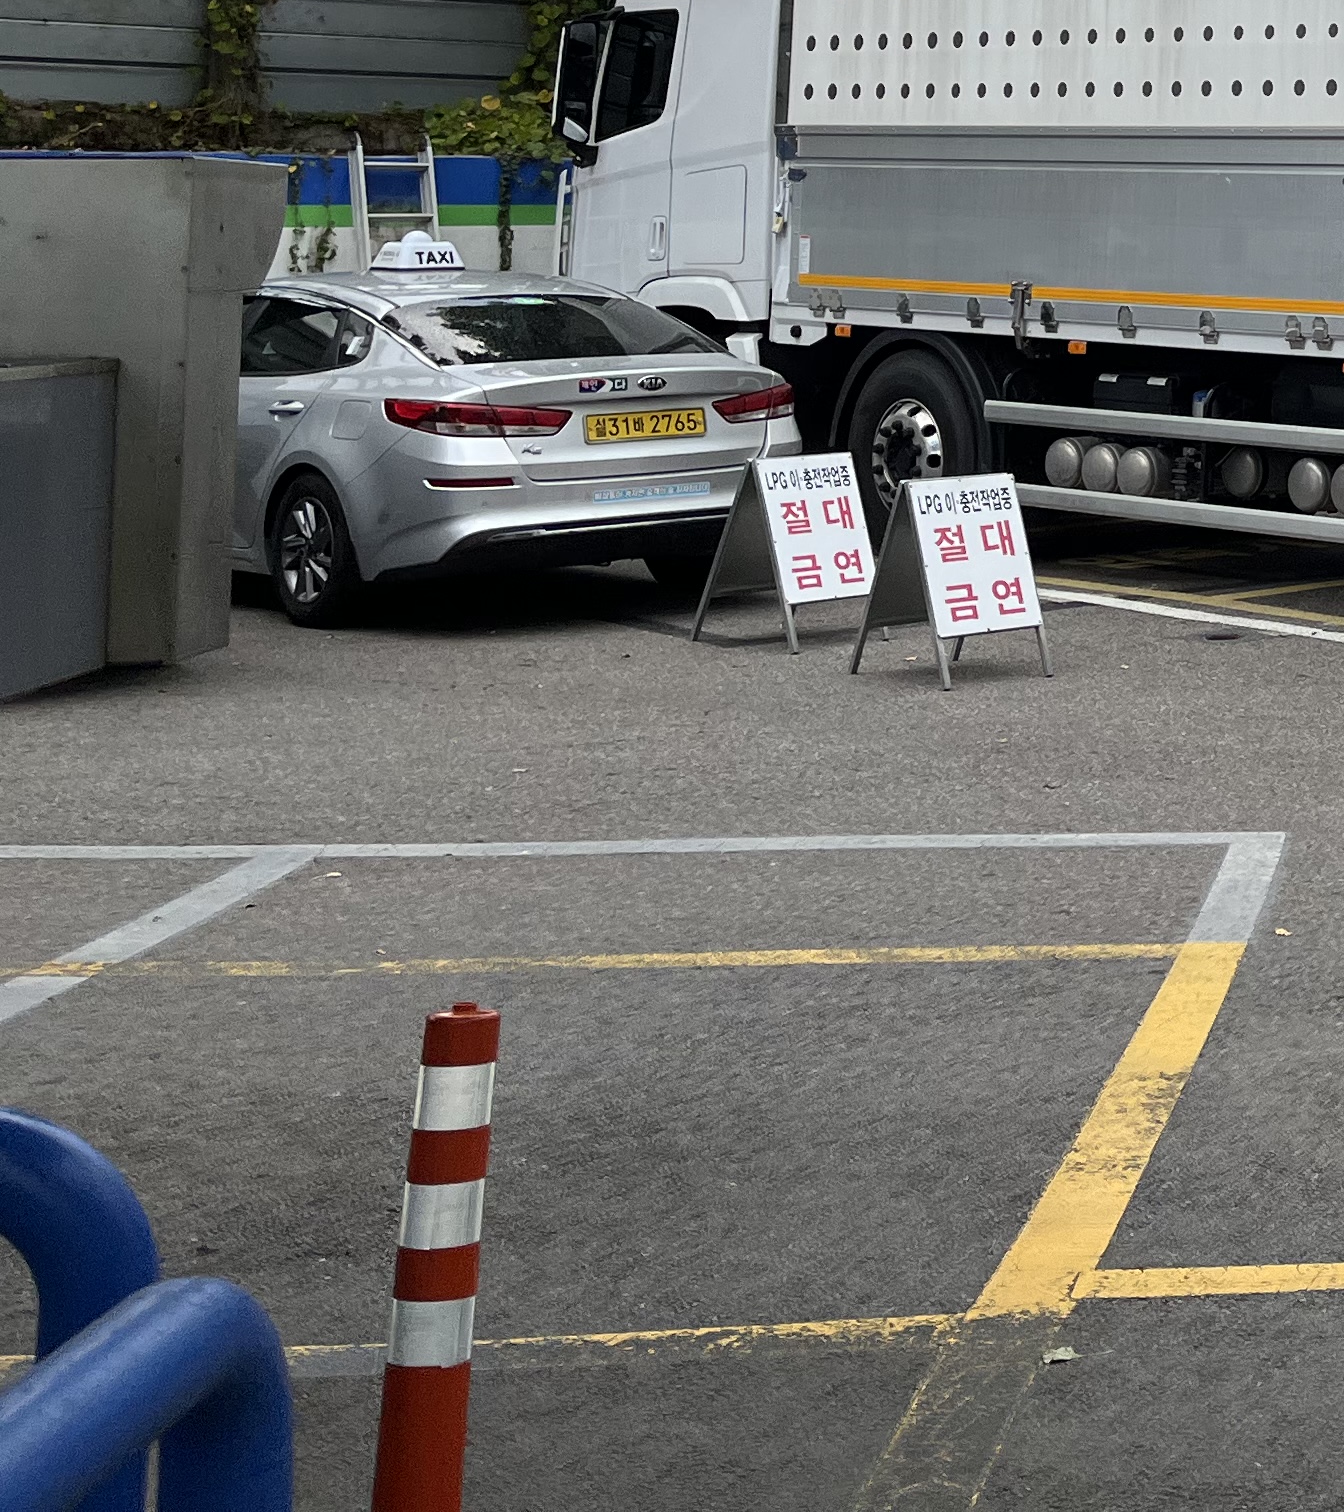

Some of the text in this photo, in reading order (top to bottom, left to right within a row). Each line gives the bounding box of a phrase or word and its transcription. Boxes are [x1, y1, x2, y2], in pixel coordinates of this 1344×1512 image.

[415, 251, 454, 265] TAXI
[643, 378, 662, 389] KIA
[649, 413, 697, 434] 2765
[765, 470, 788, 491] LPG
[780, 495, 855, 536] 절대
[917, 494, 943, 516] LPG
[933, 519, 1016, 564] 절대
[791, 548, 865, 590] 금연
[944, 577, 1026, 623] 금연
